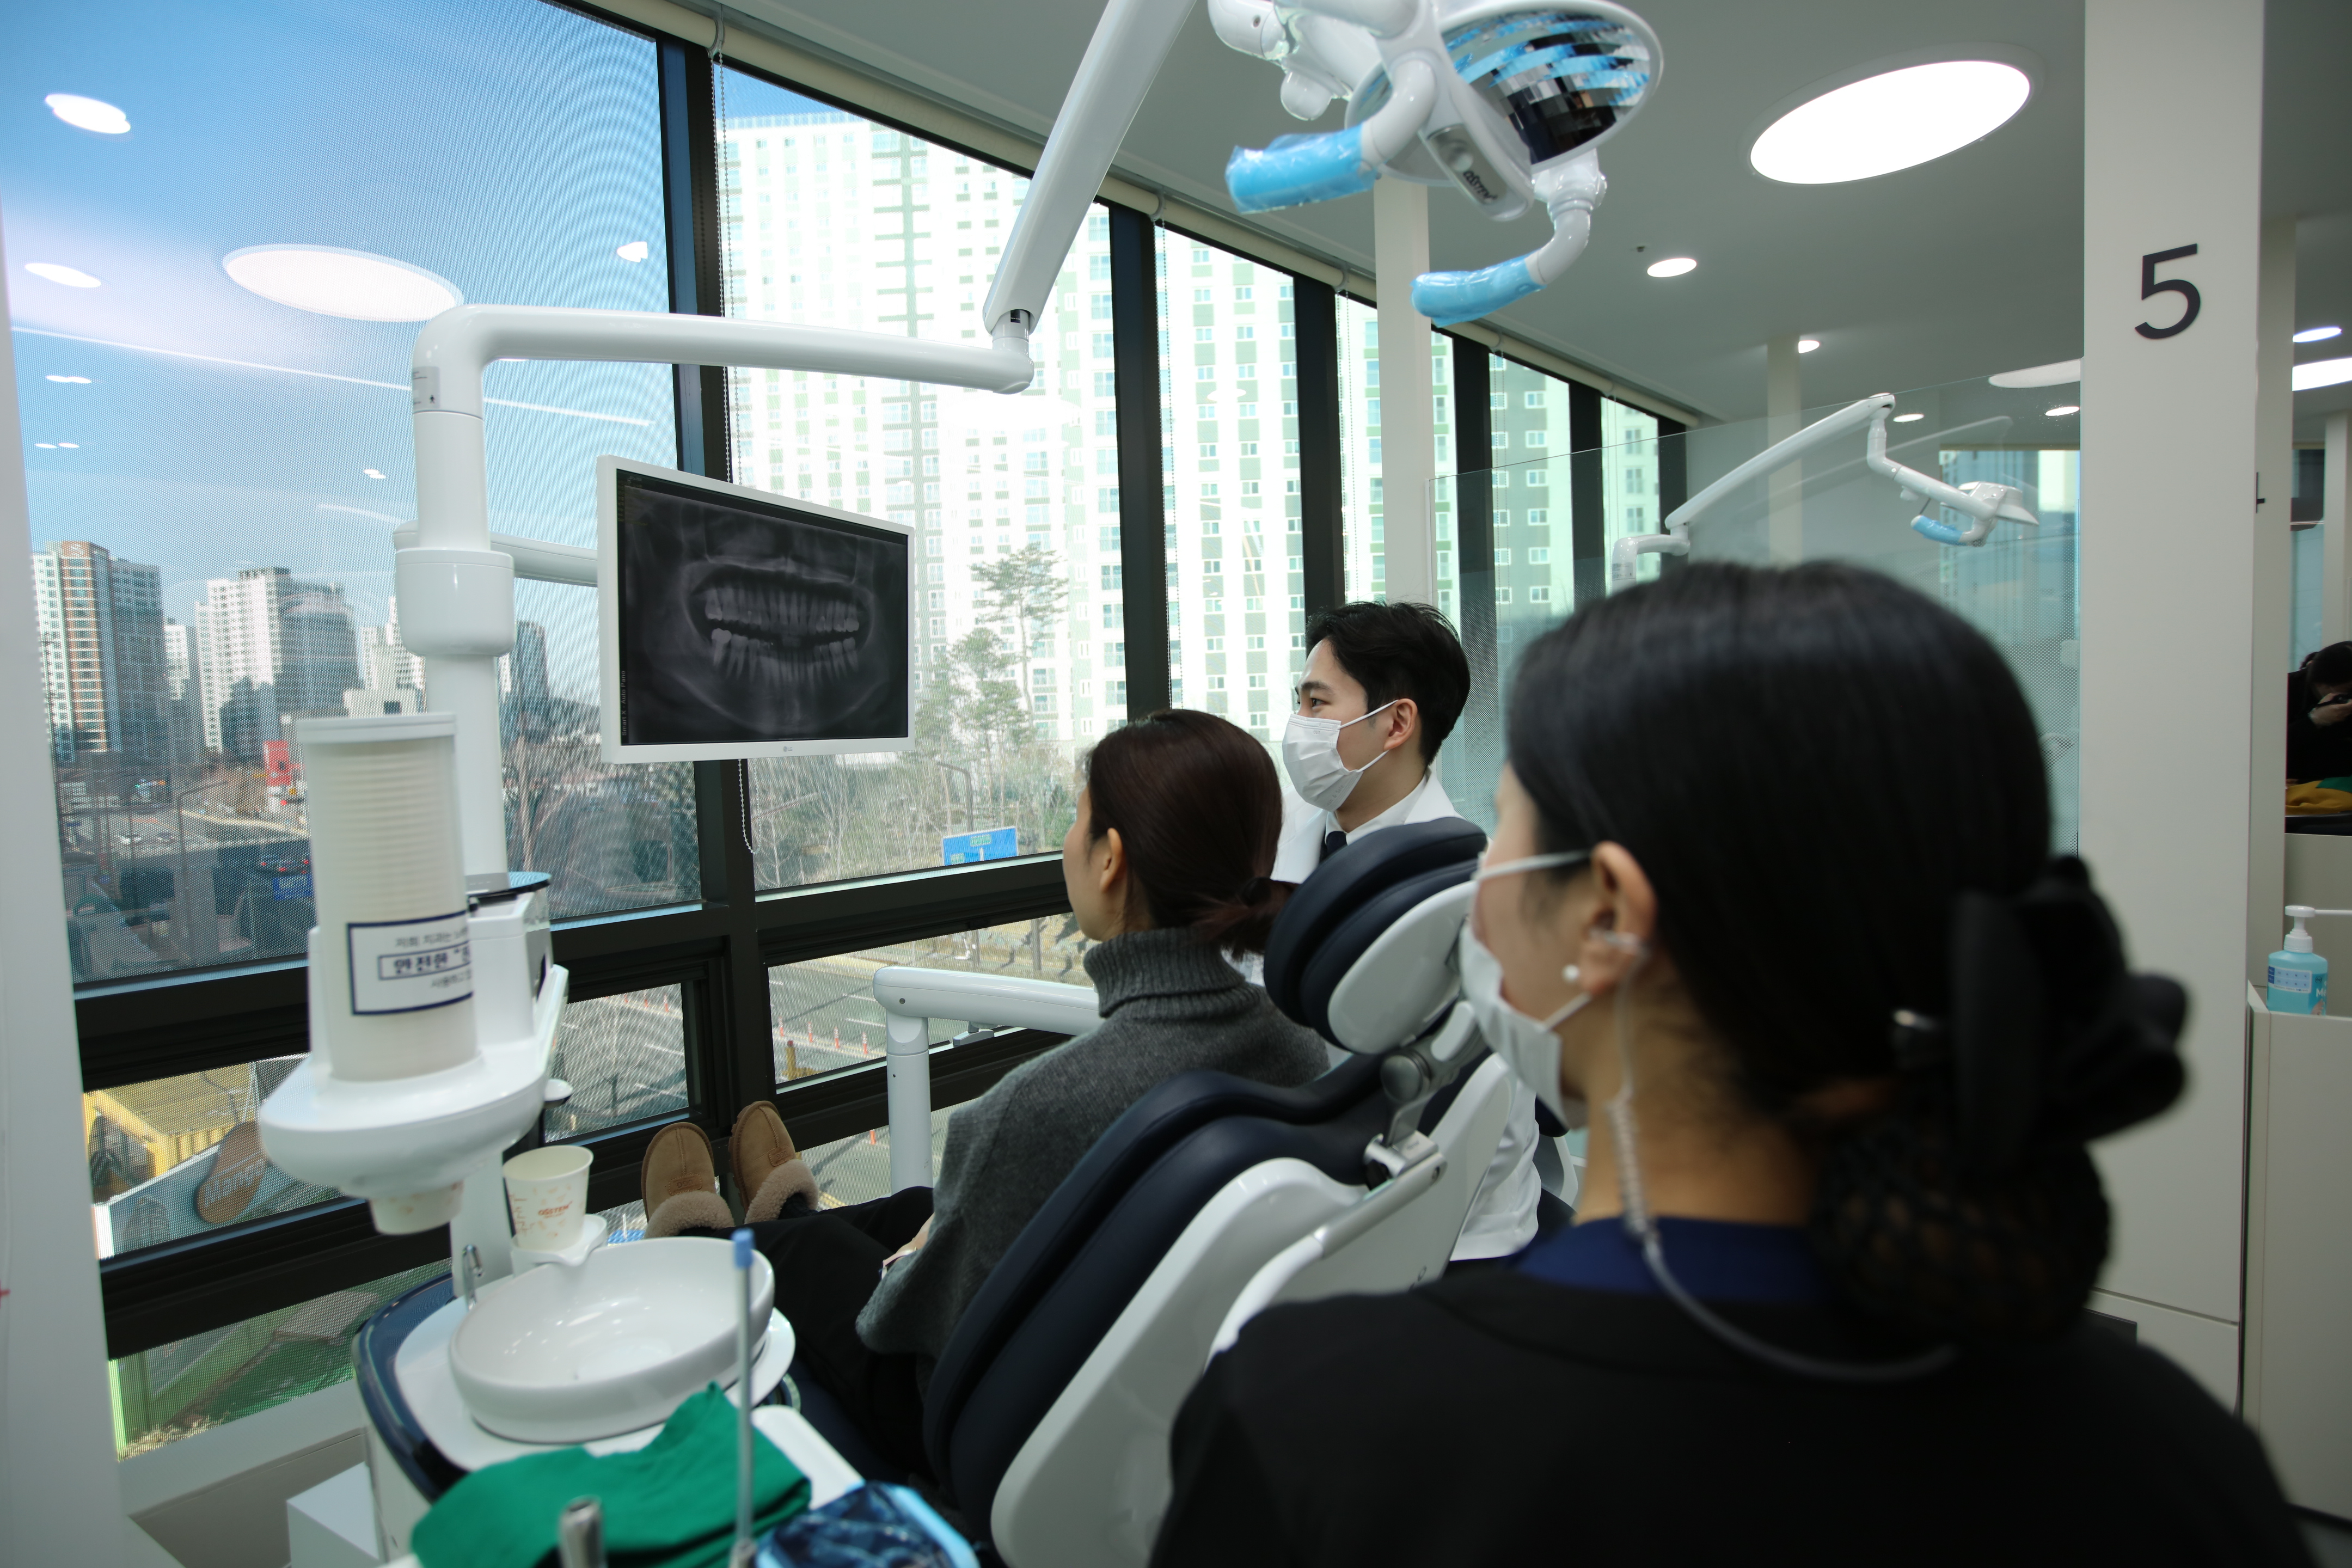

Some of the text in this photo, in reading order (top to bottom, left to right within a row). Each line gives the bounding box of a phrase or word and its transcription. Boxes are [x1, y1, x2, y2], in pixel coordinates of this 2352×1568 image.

[2134, 243, 2201, 340] 5
[1336, 785, 1344, 794] Safe
[394, 952, 449, 974] 안전한
[776, 1150, 788, 1159] UGG
[204, 1159, 265, 1208] Mango
[677, 1179, 693, 1188] UGG
